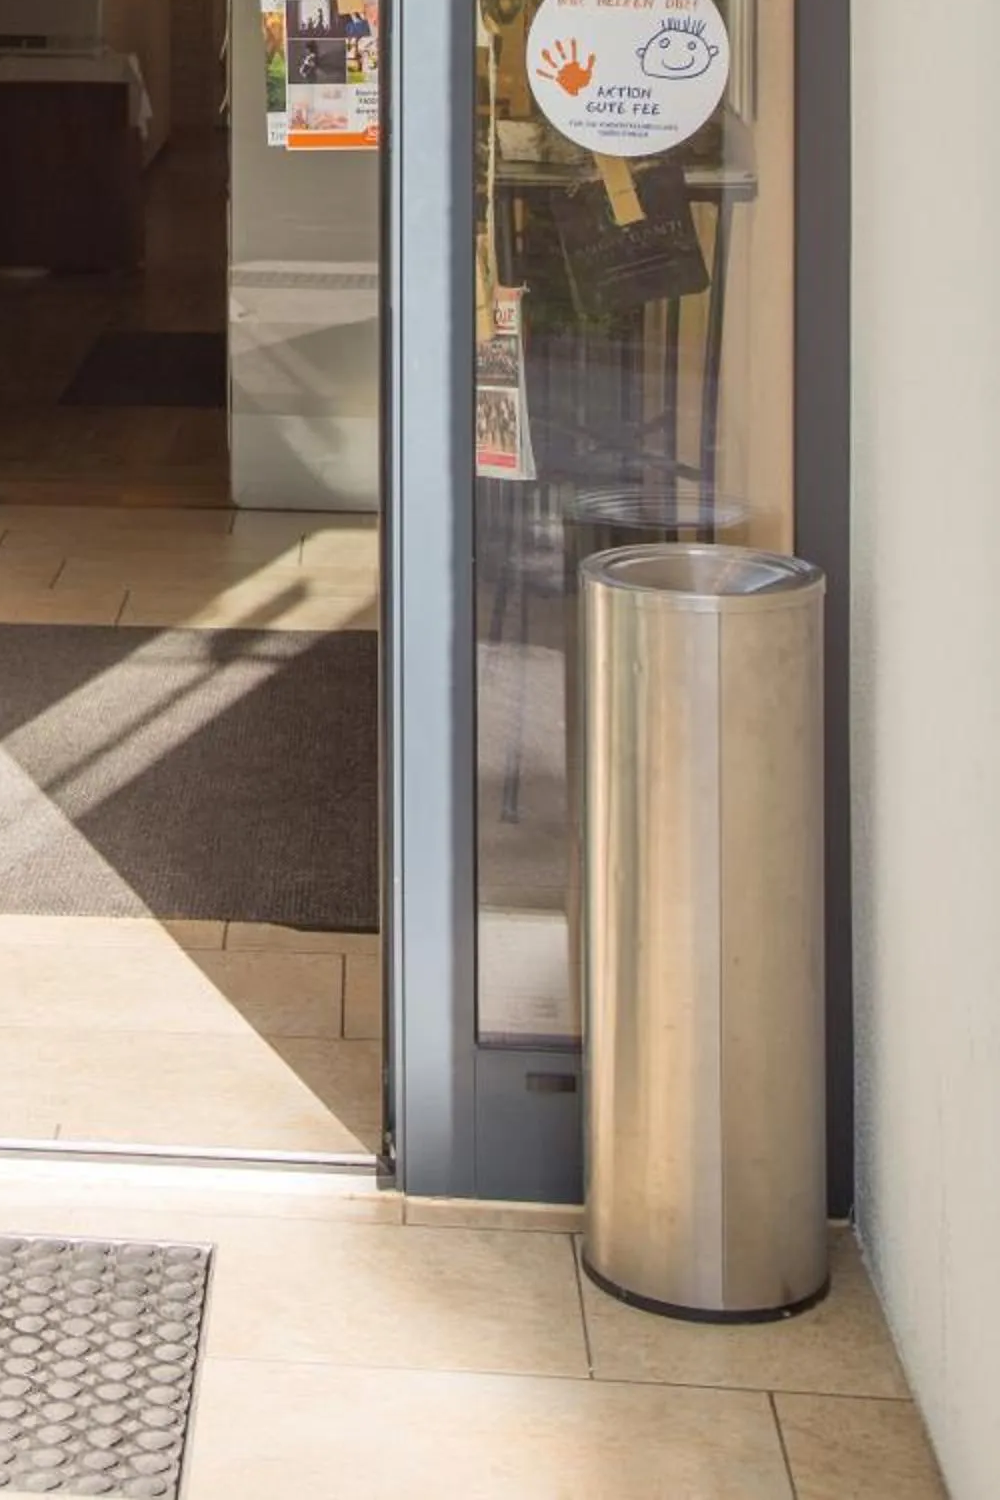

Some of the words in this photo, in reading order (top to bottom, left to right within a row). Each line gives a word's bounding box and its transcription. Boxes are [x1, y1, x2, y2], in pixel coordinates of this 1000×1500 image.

[597, 85, 652, 98] AKTION
[586, 101, 625, 115] GUTE
[632, 102, 661, 116] FEE
